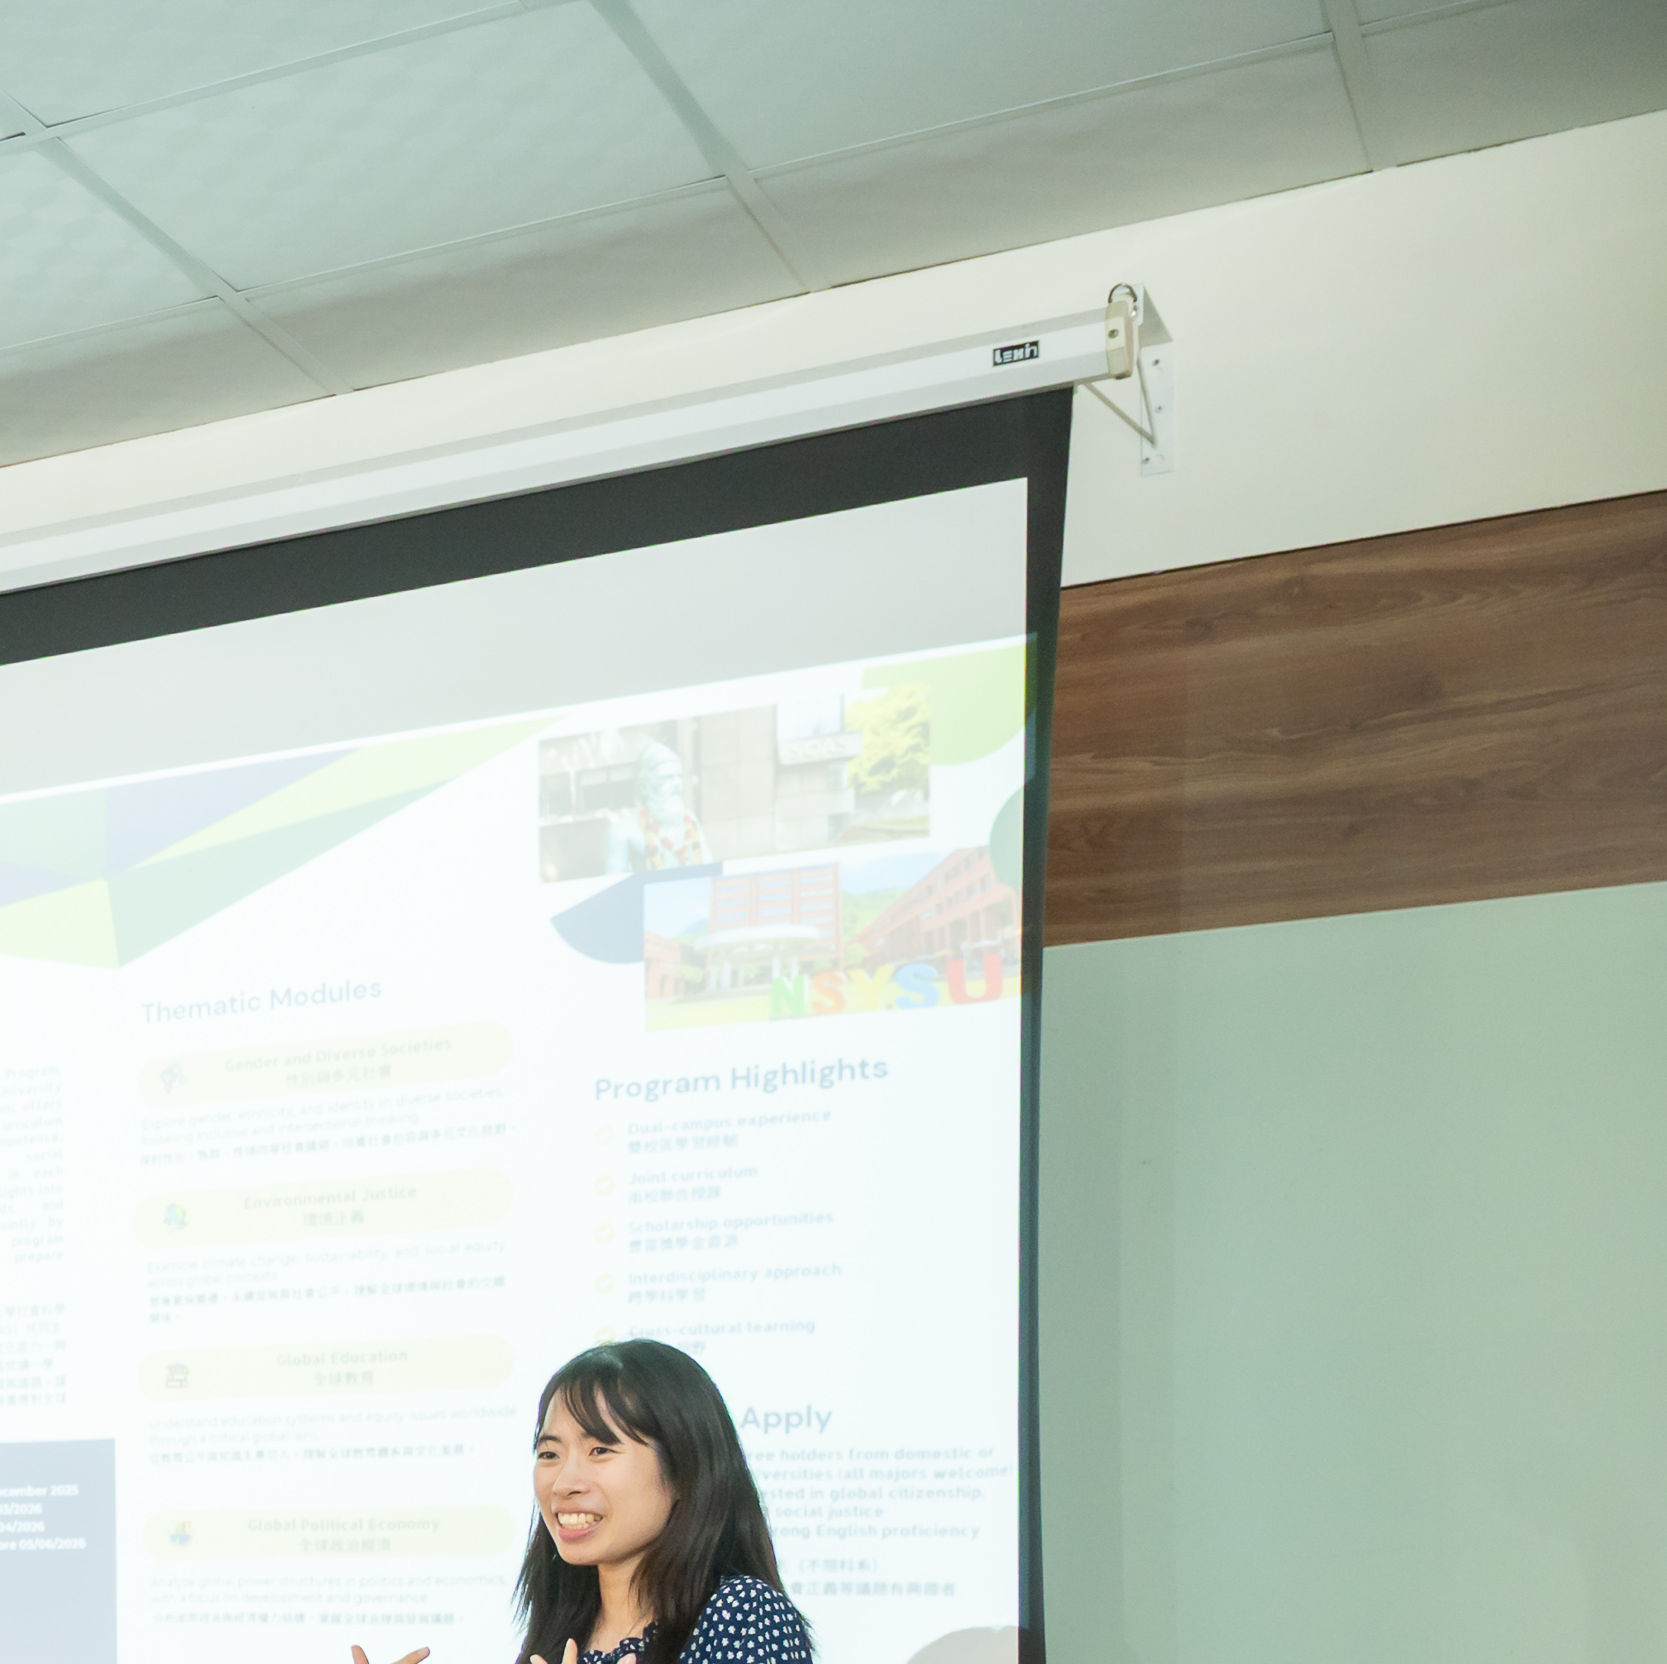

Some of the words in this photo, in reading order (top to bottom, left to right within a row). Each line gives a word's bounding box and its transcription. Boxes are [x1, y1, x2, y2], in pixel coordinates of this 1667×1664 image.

[771, 953, 1002, 1018] NSYSU
[141, 991, 261, 1023] Thematic
[270, 980, 383, 1010] Modules
[224, 1056, 279, 1072] Gender
[283, 1050, 313, 1067] and
[315, 1047, 377, 1064] Diverse
[381, 1038, 452, 1057] Societies
[595, 1074, 721, 1102] Program
[731, 1058, 888, 1094] Highlights
[627, 1117, 732, 1136] Dual-campus
[736, 1110, 832, 1128] experience
[629, 1171, 667, 1185] Joint
[671, 1166, 758, 1182] curriculum
[243, 1189, 357, 1210] Environmental
[362, 1184, 417, 1202] Justice
[628, 1217, 719, 1233] Scholarship
[722, 1211, 834, 1232] opportunities
[628, 1269, 759, 1285] Interdisciplinary
[764, 1262, 842, 1281] approach
[627, 1321, 742, 1337] Cross-cultural
[746, 1320, 816, 1335] learning
[276, 1352, 326, 1367] Global
[330, 1349, 409, 1366] Education
[740, 1404, 833, 1435] Apply
[779, 1448, 844, 1461] holders
[848, 1447, 889, 1461] from
[893, 1447, 971, 1460] domestic
[978, 1447, 995, 1459] or
[869, 1467, 927, 1483] majors
[50, 1484, 79, 1496] 2025
[809, 1487, 825, 1499] in
[828, 1486, 884, 1503] global
[888, 1486, 984, 1501] citizenship,
[776, 1505, 823, 1518] social
[827, 1505, 884, 1521] justice
[246, 1518, 297, 1532] Global
[300, 1518, 364, 1532] Political
[367, 1517, 441, 1534] Economy
[773, 1526, 811, 1542] rong
[815, 1523, 877, 1541] English
[881, 1525, 981, 1541] proficiency
[18, 1537, 87, 1550] 05/06/2026
